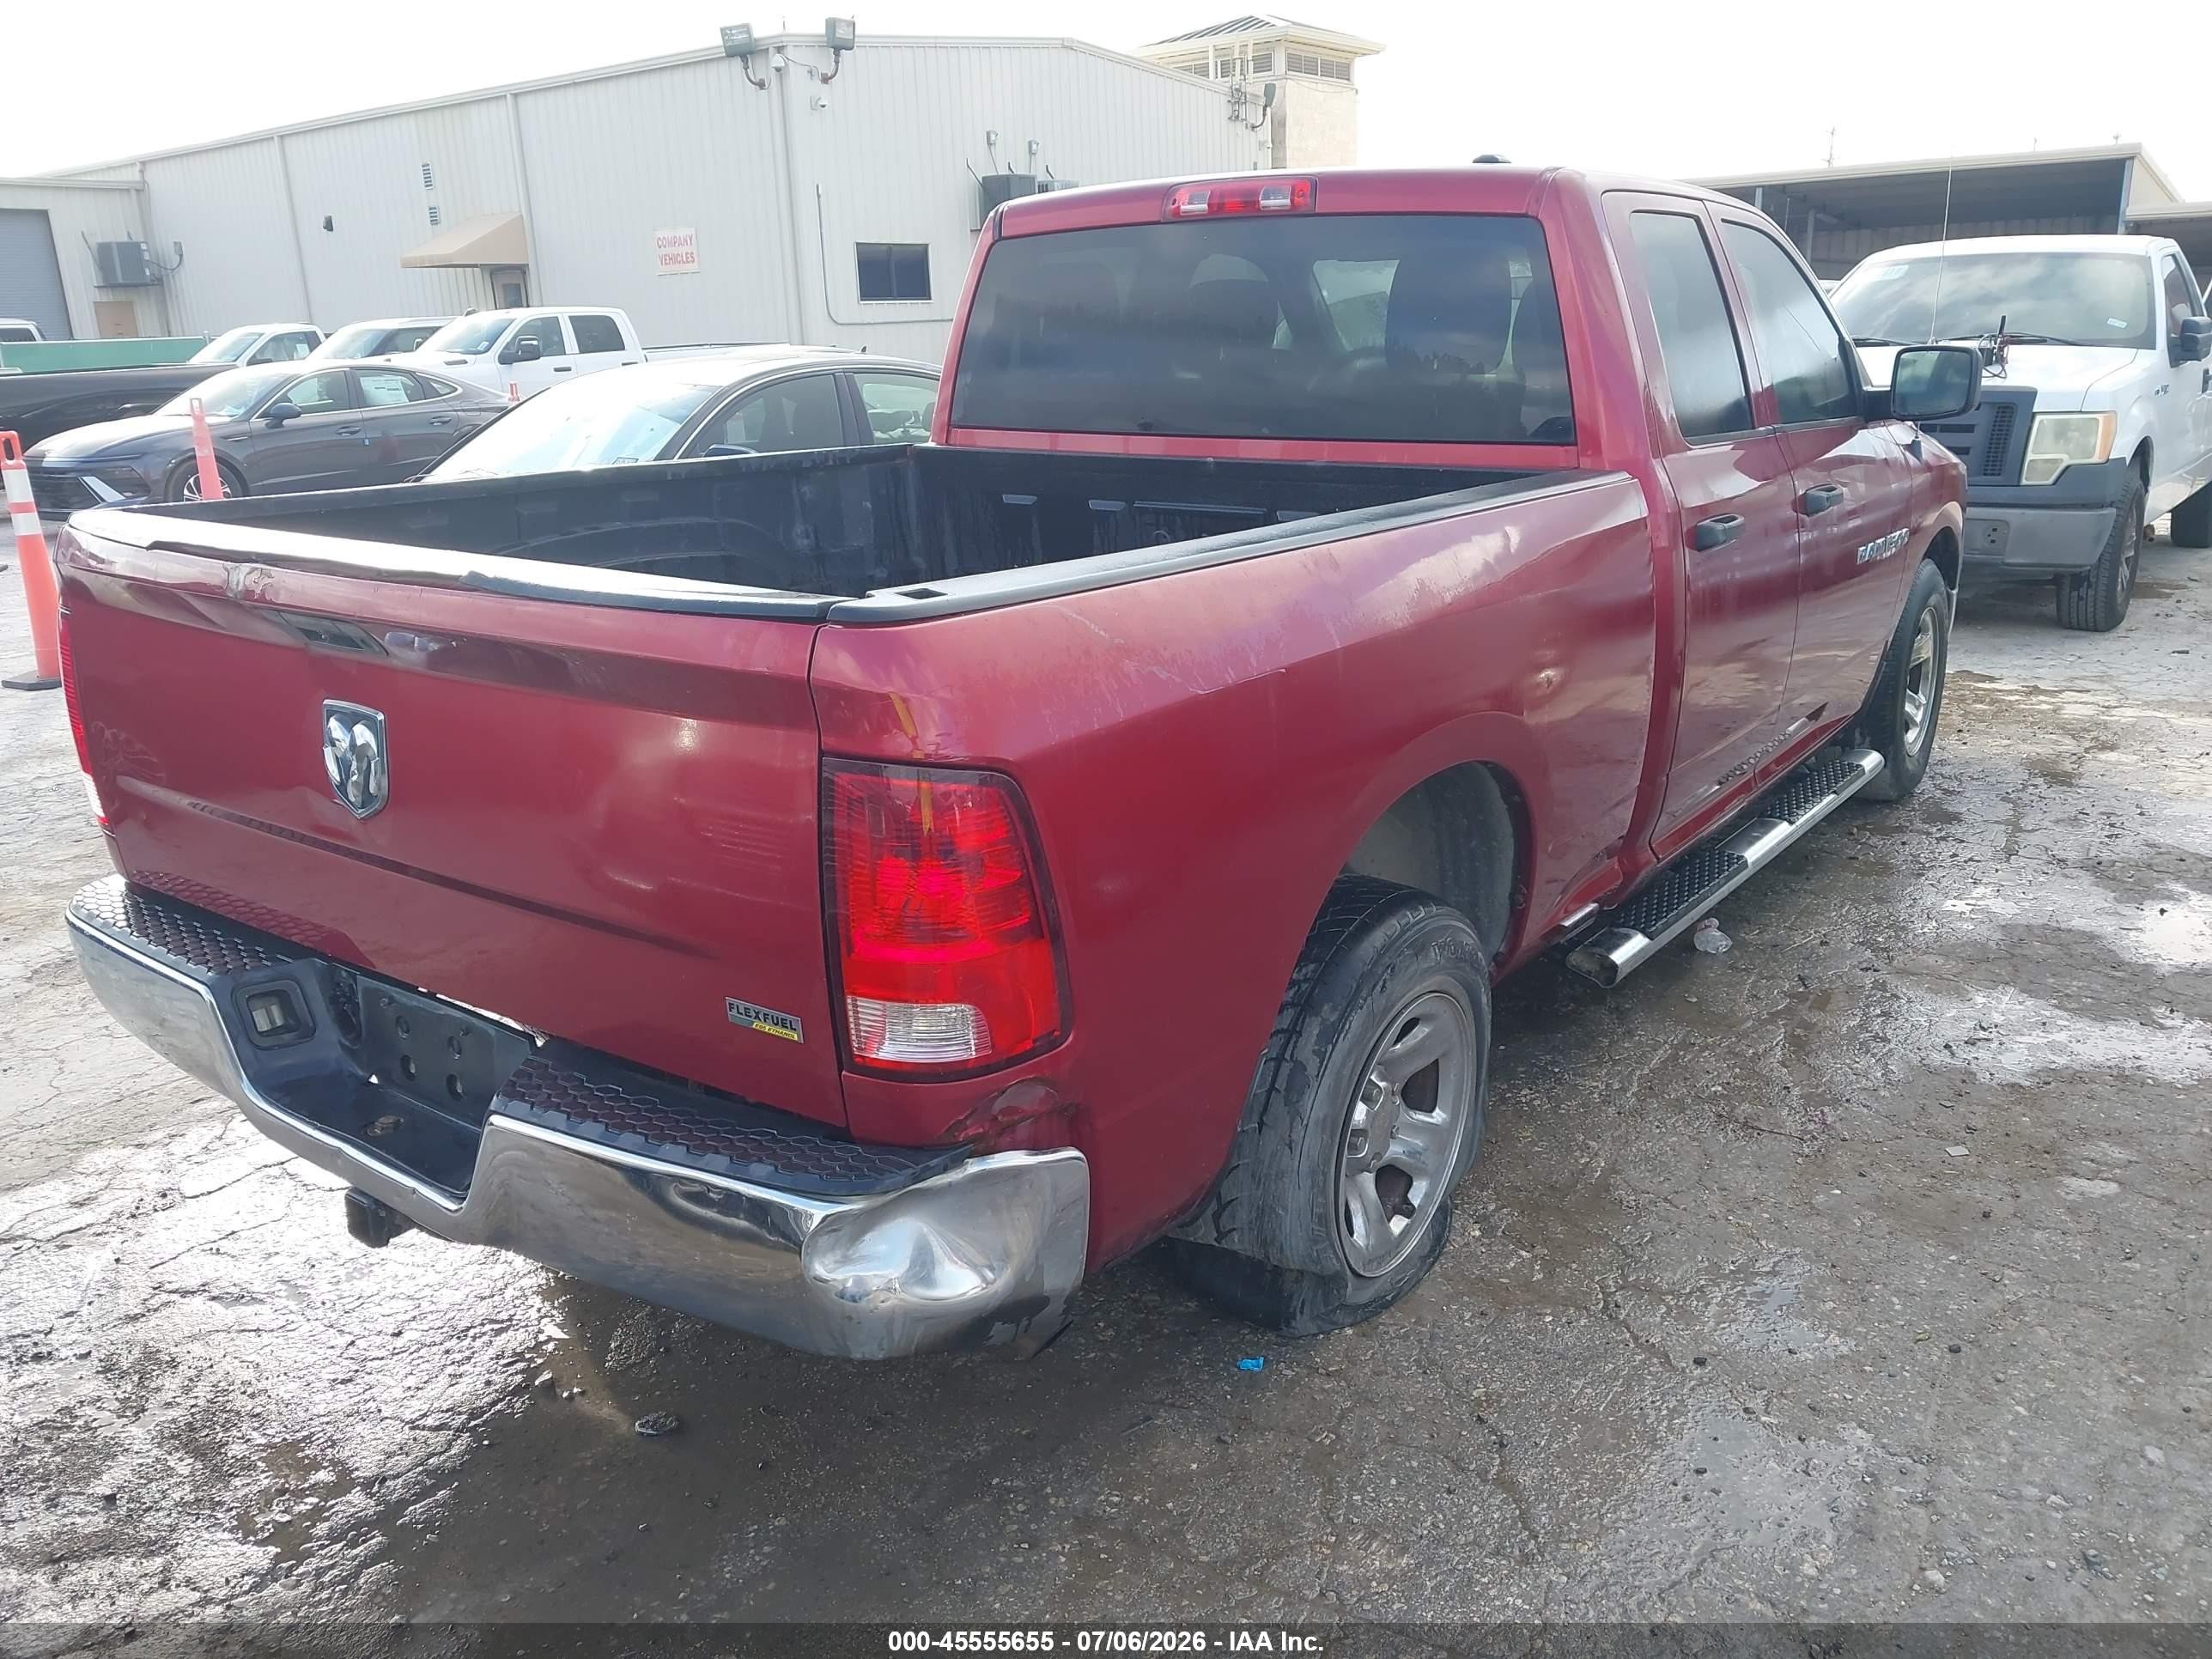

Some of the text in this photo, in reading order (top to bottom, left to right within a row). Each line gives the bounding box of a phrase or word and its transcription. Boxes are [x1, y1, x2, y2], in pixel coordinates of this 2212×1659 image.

[656, 234, 694, 249] COMPANY
[659, 251, 696, 266] VEHICLES
[728, 1001, 798, 1032] FLEXFUEL
[767, 1026, 796, 1039] ETHANOL
